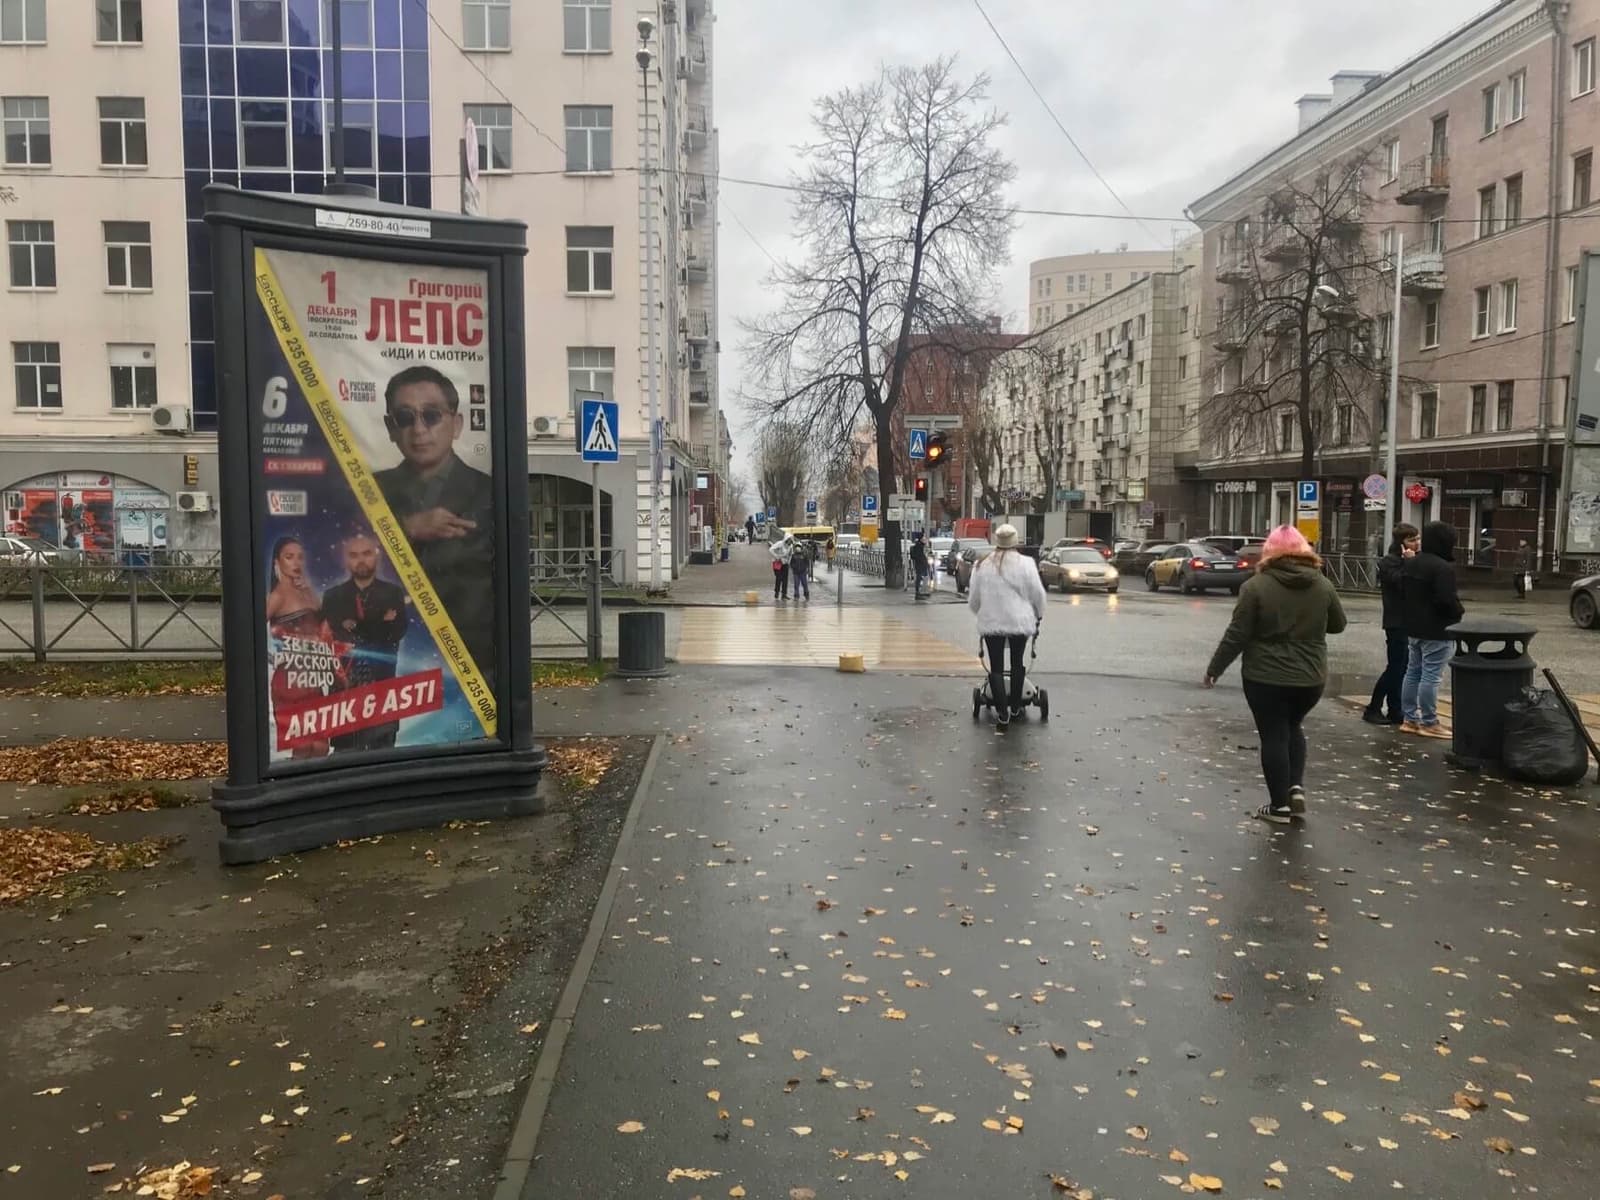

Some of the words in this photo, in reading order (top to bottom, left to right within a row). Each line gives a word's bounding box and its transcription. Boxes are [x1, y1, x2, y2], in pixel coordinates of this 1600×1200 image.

[348, 217, 399, 232] 259-80-40
[320, 270, 337, 304] 1
[409, 278, 483, 301] Григорий
[307, 304, 358, 319] ДЕКАБРЯ
[365, 297, 483, 347] ЛЕПС
[257, 273, 292, 333] кассы.рф
[285, 337, 305, 361] 235
[296, 358, 319, 388] 0000
[380, 346, 414, 360] «ИДИ
[417, 349, 426, 360] И
[430, 349, 484, 363] СМОТРИ»
[262, 375, 288, 420] 6
[262, 435, 303, 450] ПЯТНИЦА
[263, 421, 309, 435] ДЕКАБРЯ
[317, 399, 351, 456] кассы.рф
[346, 458, 364, 483] 235
[357, 477, 379, 507] 0000
[377, 515, 412, 568] кассы.рф
[407, 570, 425, 597] 235
[417, 590, 439, 617] 0000
[273, 652, 341, 672] РУССКОГО
[438, 624, 472, 677] кассы.рф
[466, 677, 485, 706] 235
[284, 697, 357, 742] ARTIK
[362, 693, 376, 719] &
[381, 679, 436, 715] ASTI
[475, 697, 497, 723] 0000
